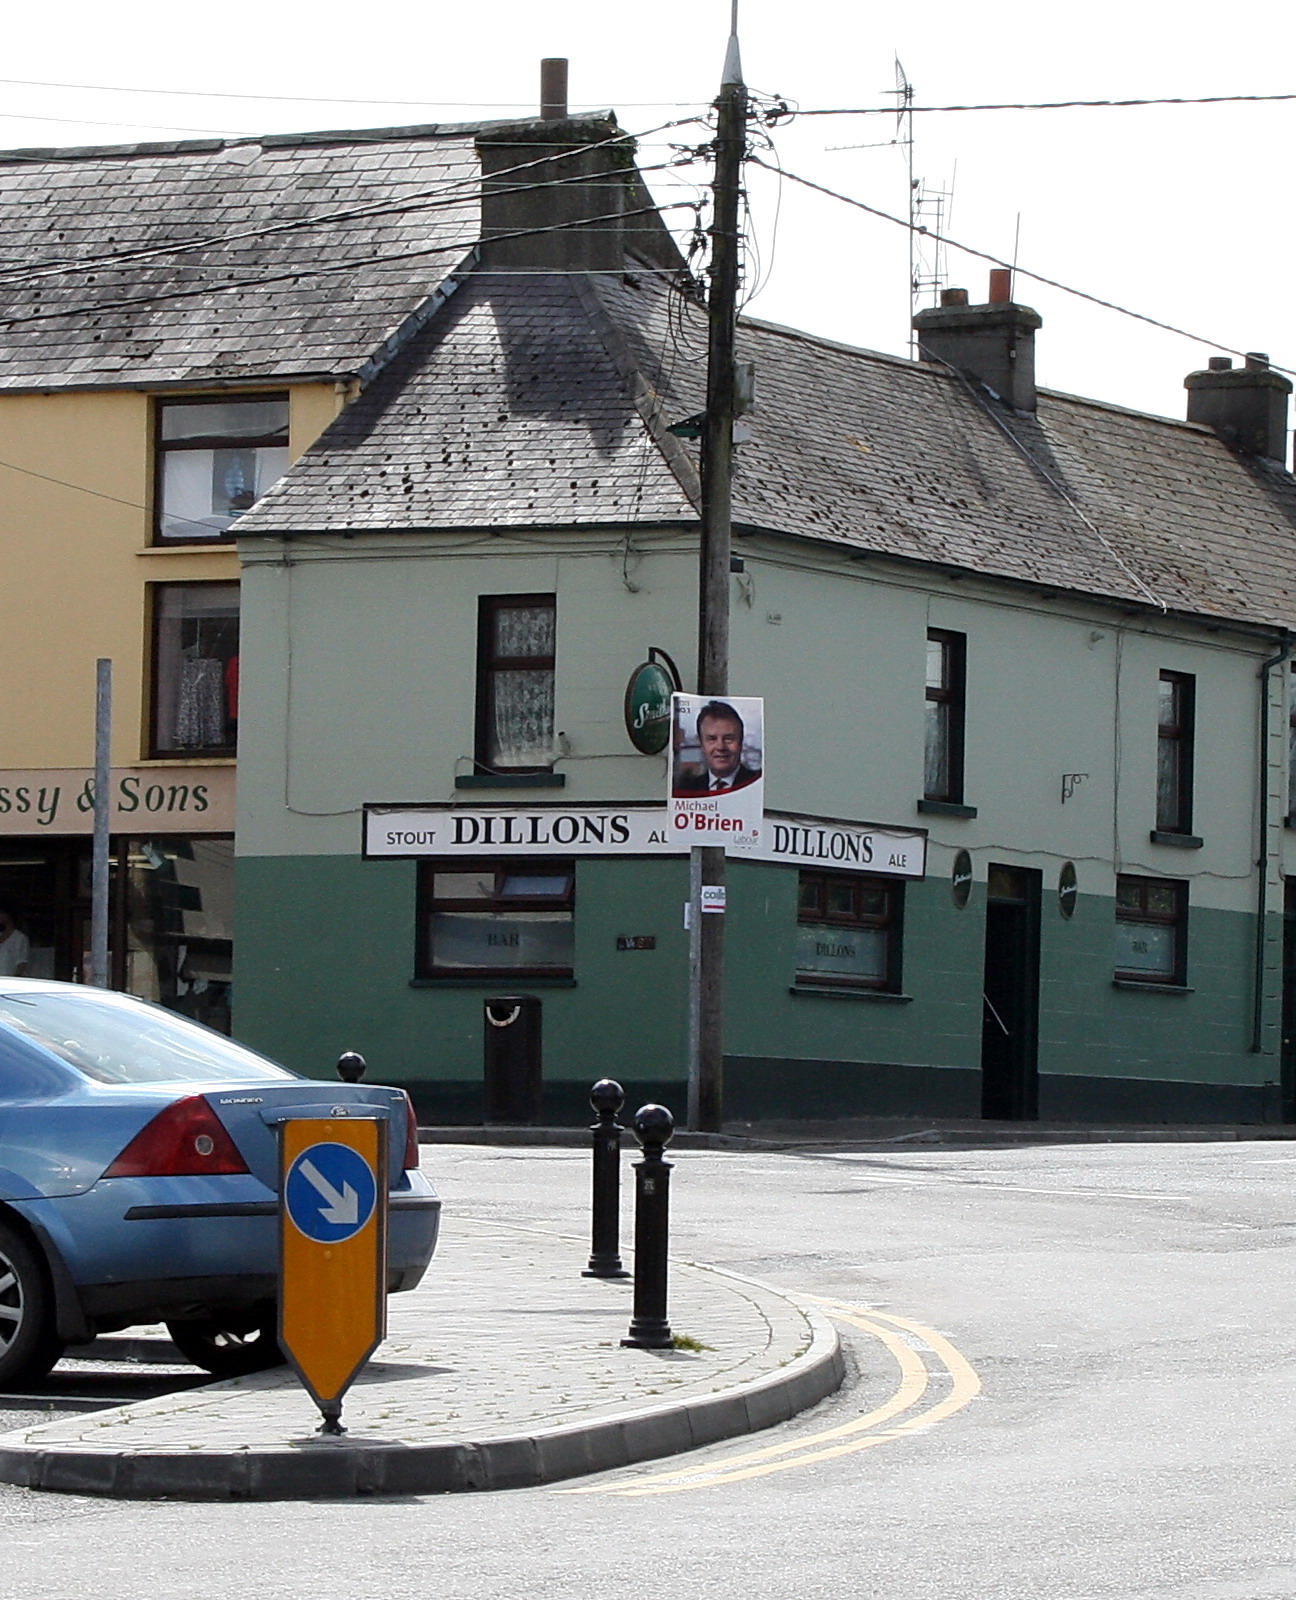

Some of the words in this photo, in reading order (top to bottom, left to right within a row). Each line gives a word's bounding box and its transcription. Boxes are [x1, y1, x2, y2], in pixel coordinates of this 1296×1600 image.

[77, 778, 95, 812] &
[117, 775, 209, 813] Sons
[674, 801, 718, 811] Michael
[386, 831, 436, 845] STOUT
[450, 814, 631, 845] DILLONS
[647, 830, 668, 844] AL
[674, 811, 743, 831] O'Brien
[772, 825, 873, 864] DILLONS
[888, 853, 907, 867] ALE
